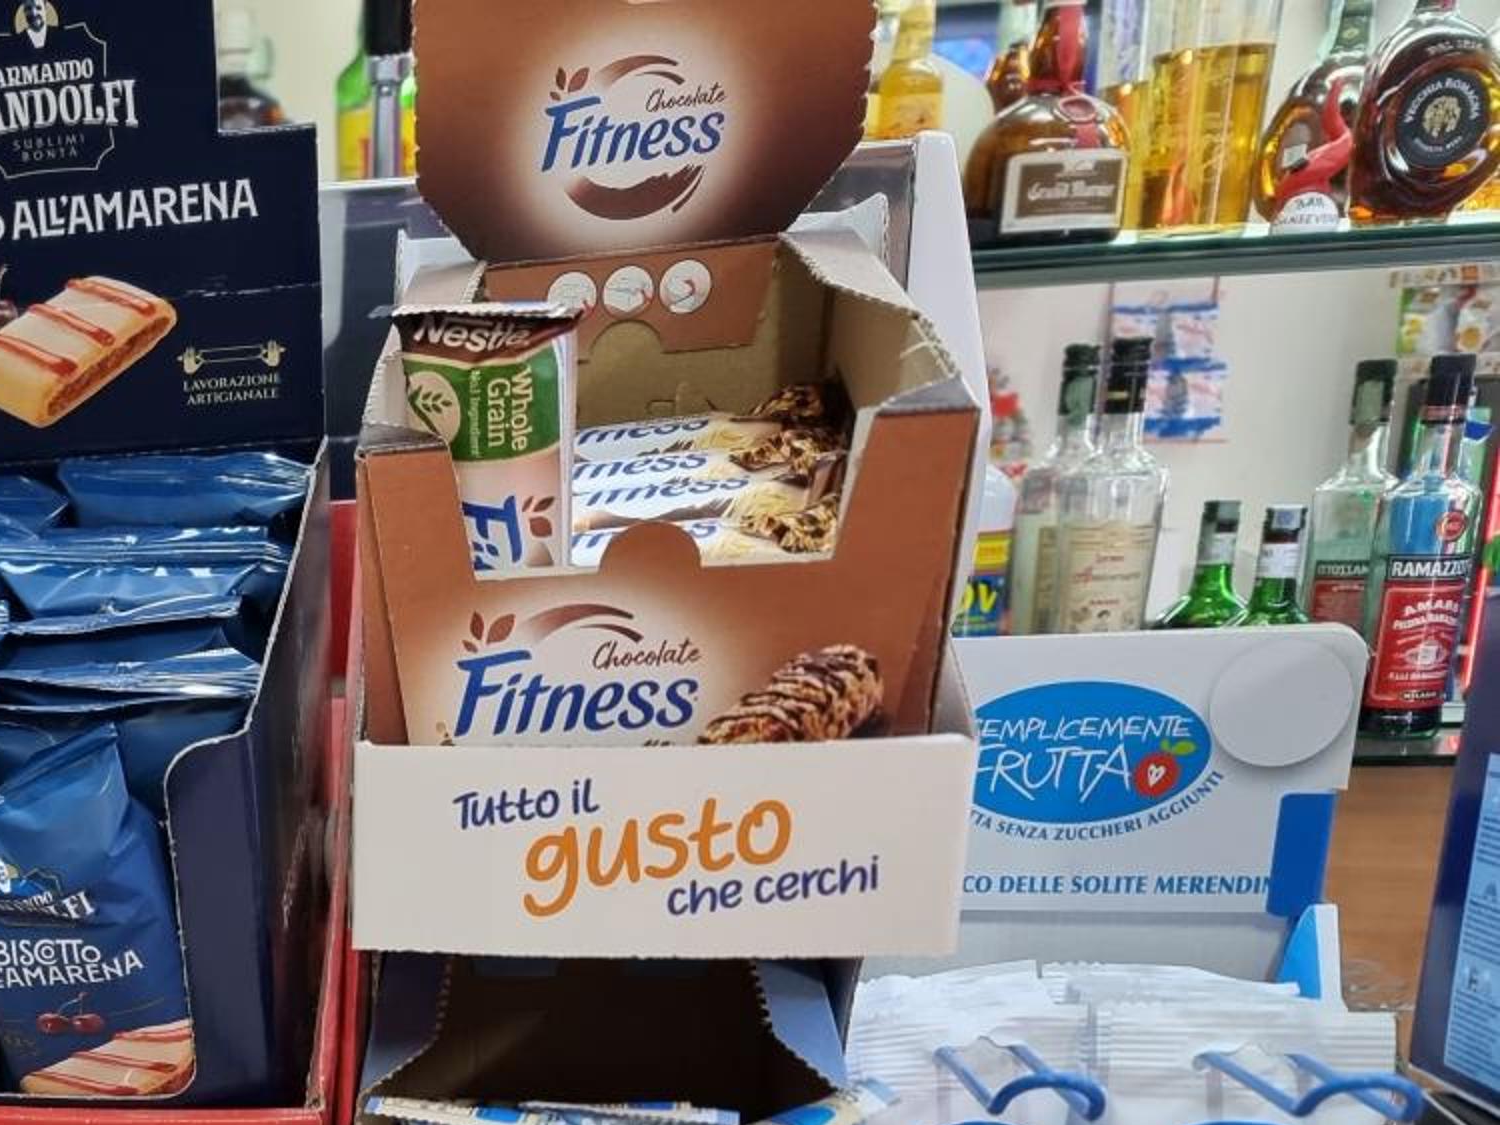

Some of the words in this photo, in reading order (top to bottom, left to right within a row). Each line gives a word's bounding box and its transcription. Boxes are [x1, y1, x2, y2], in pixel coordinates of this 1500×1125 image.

[646, 81, 726, 112] Chocolate
[13, 134, 85, 151] SUBLIMI
[541, 96, 725, 172] Fitness
[12, 178, 258, 239] ALL'AMARENA
[183, 373, 282, 393] LAVORAZIONE
[187, 388, 279, 406] ARTIGIANALE
[487, 377, 510, 448] Grain
[511, 366, 533, 451] Whole
[593, 637, 700, 670] Chocolate
[453, 649, 700, 738] Fitness
[452, 788, 560, 830] Tutto
[572, 779, 599, 816] il
[996, 821, 1047, 840] SENZA
[1053, 818, 1143, 841] ZUCCHERI
[1148, 771, 1224, 826] AGGIUNTI
[523, 798, 794, 918] gusto
[667, 877, 743, 917] che
[754, 856, 879, 905] cerchi
[1008, 875, 1064, 894] DELLE
[1071, 875, 1148, 894] SOLITE
